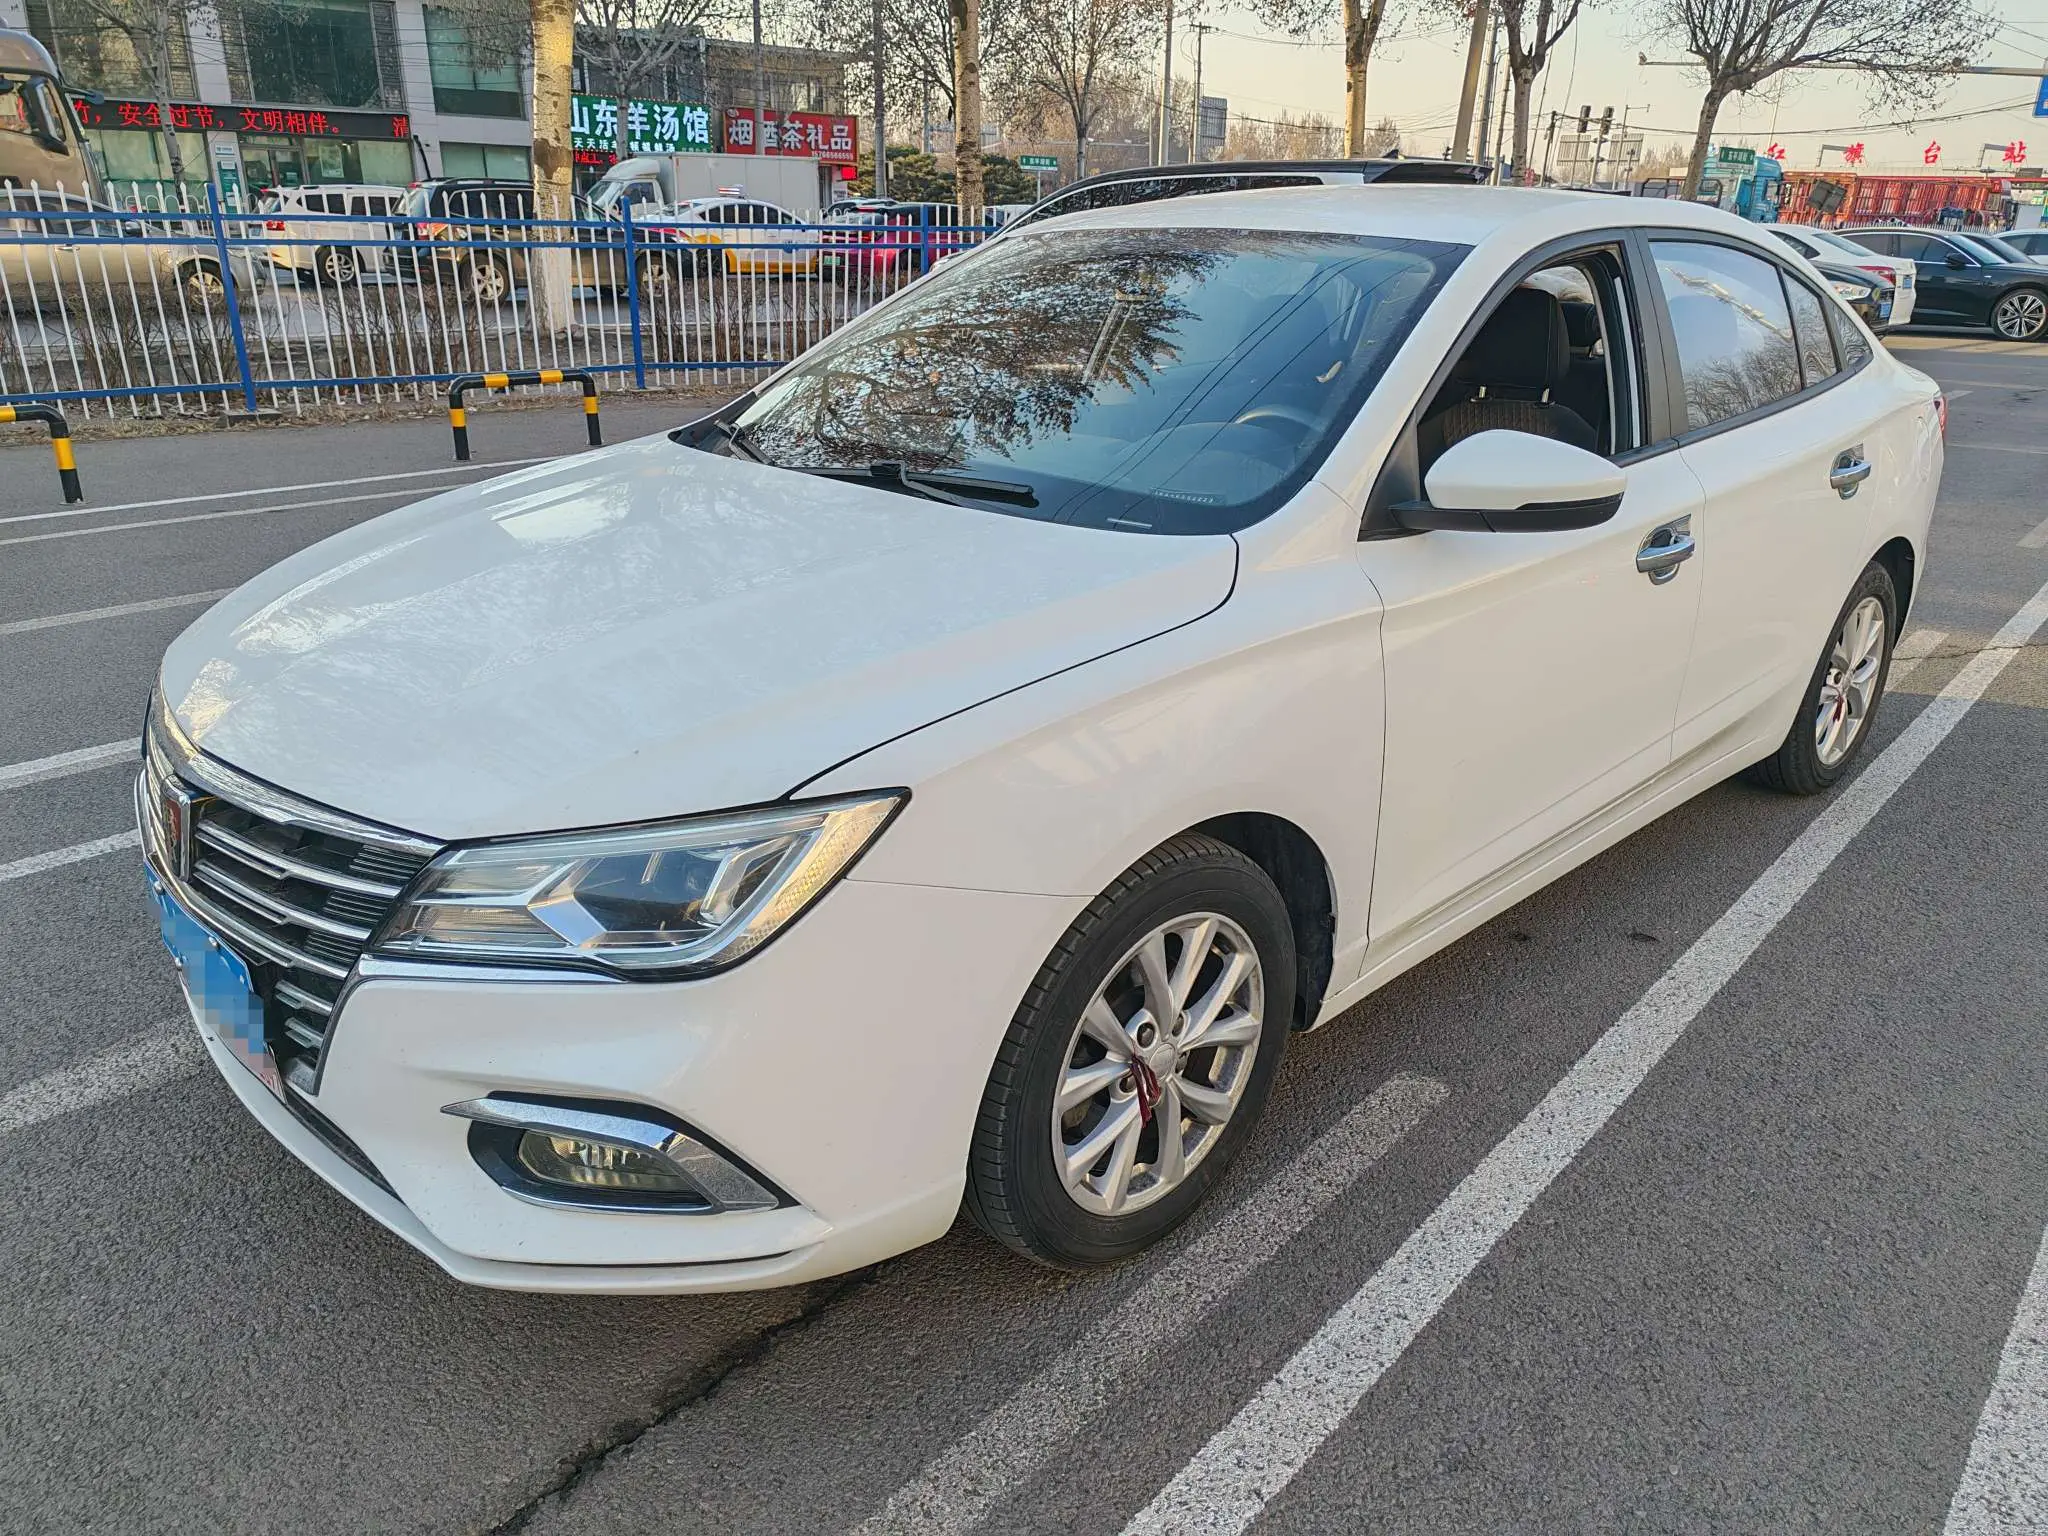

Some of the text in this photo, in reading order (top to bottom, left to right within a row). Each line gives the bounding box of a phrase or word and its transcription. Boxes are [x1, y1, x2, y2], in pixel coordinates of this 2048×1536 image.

[571, 98, 709, 143] 山东羊汤馆
[729, 119, 852, 150] 烟酒茶礼品
